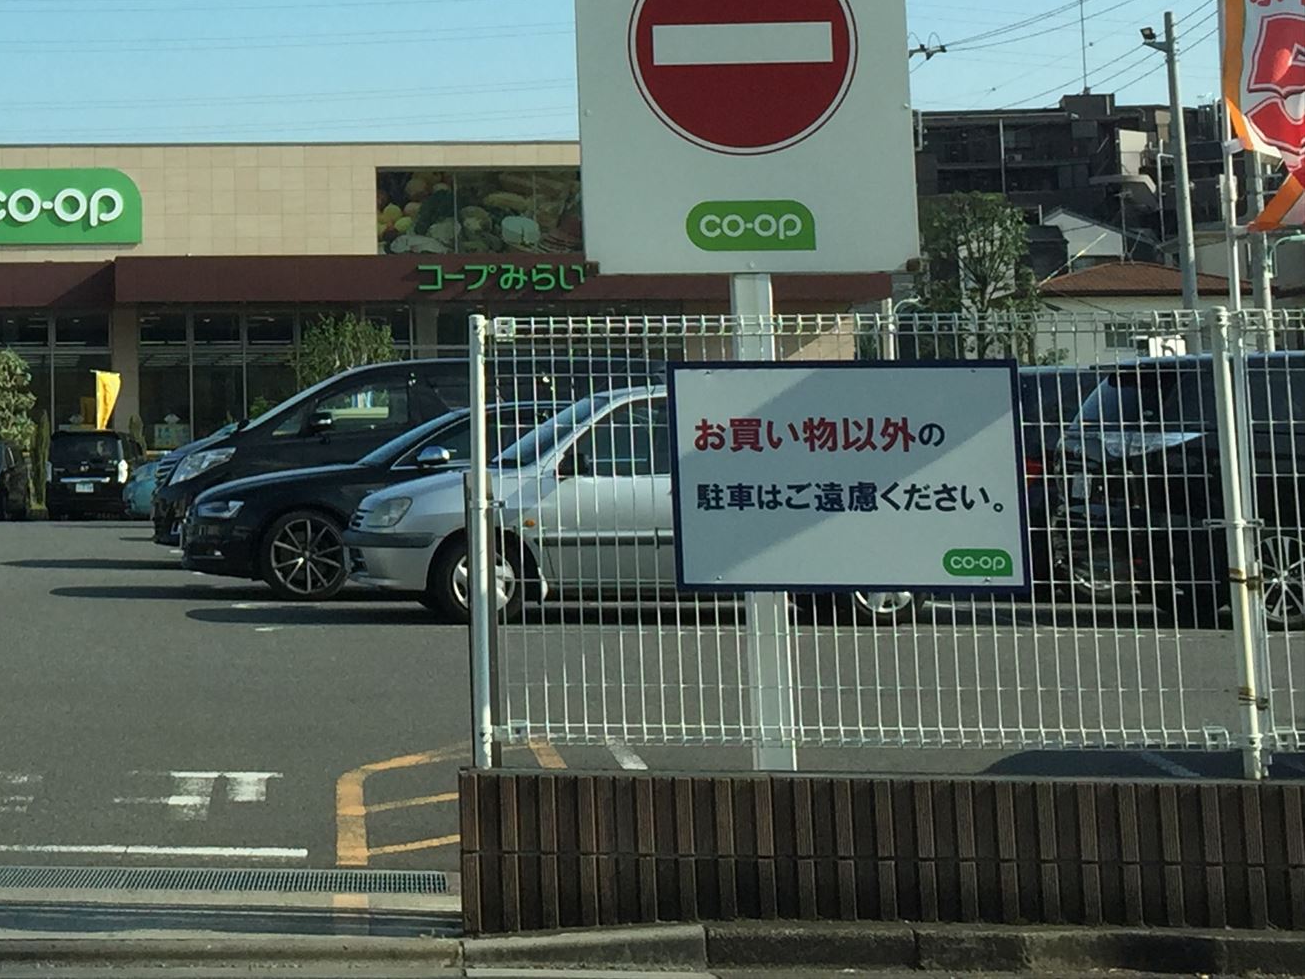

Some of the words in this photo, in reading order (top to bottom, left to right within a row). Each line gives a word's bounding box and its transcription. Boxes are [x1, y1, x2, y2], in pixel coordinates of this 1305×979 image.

[417, 264, 585, 291] コープみらい
[693, 417, 946, 452] お買い物以外の
[696, 482, 1005, 514] 駐車はご遠慮ください。
